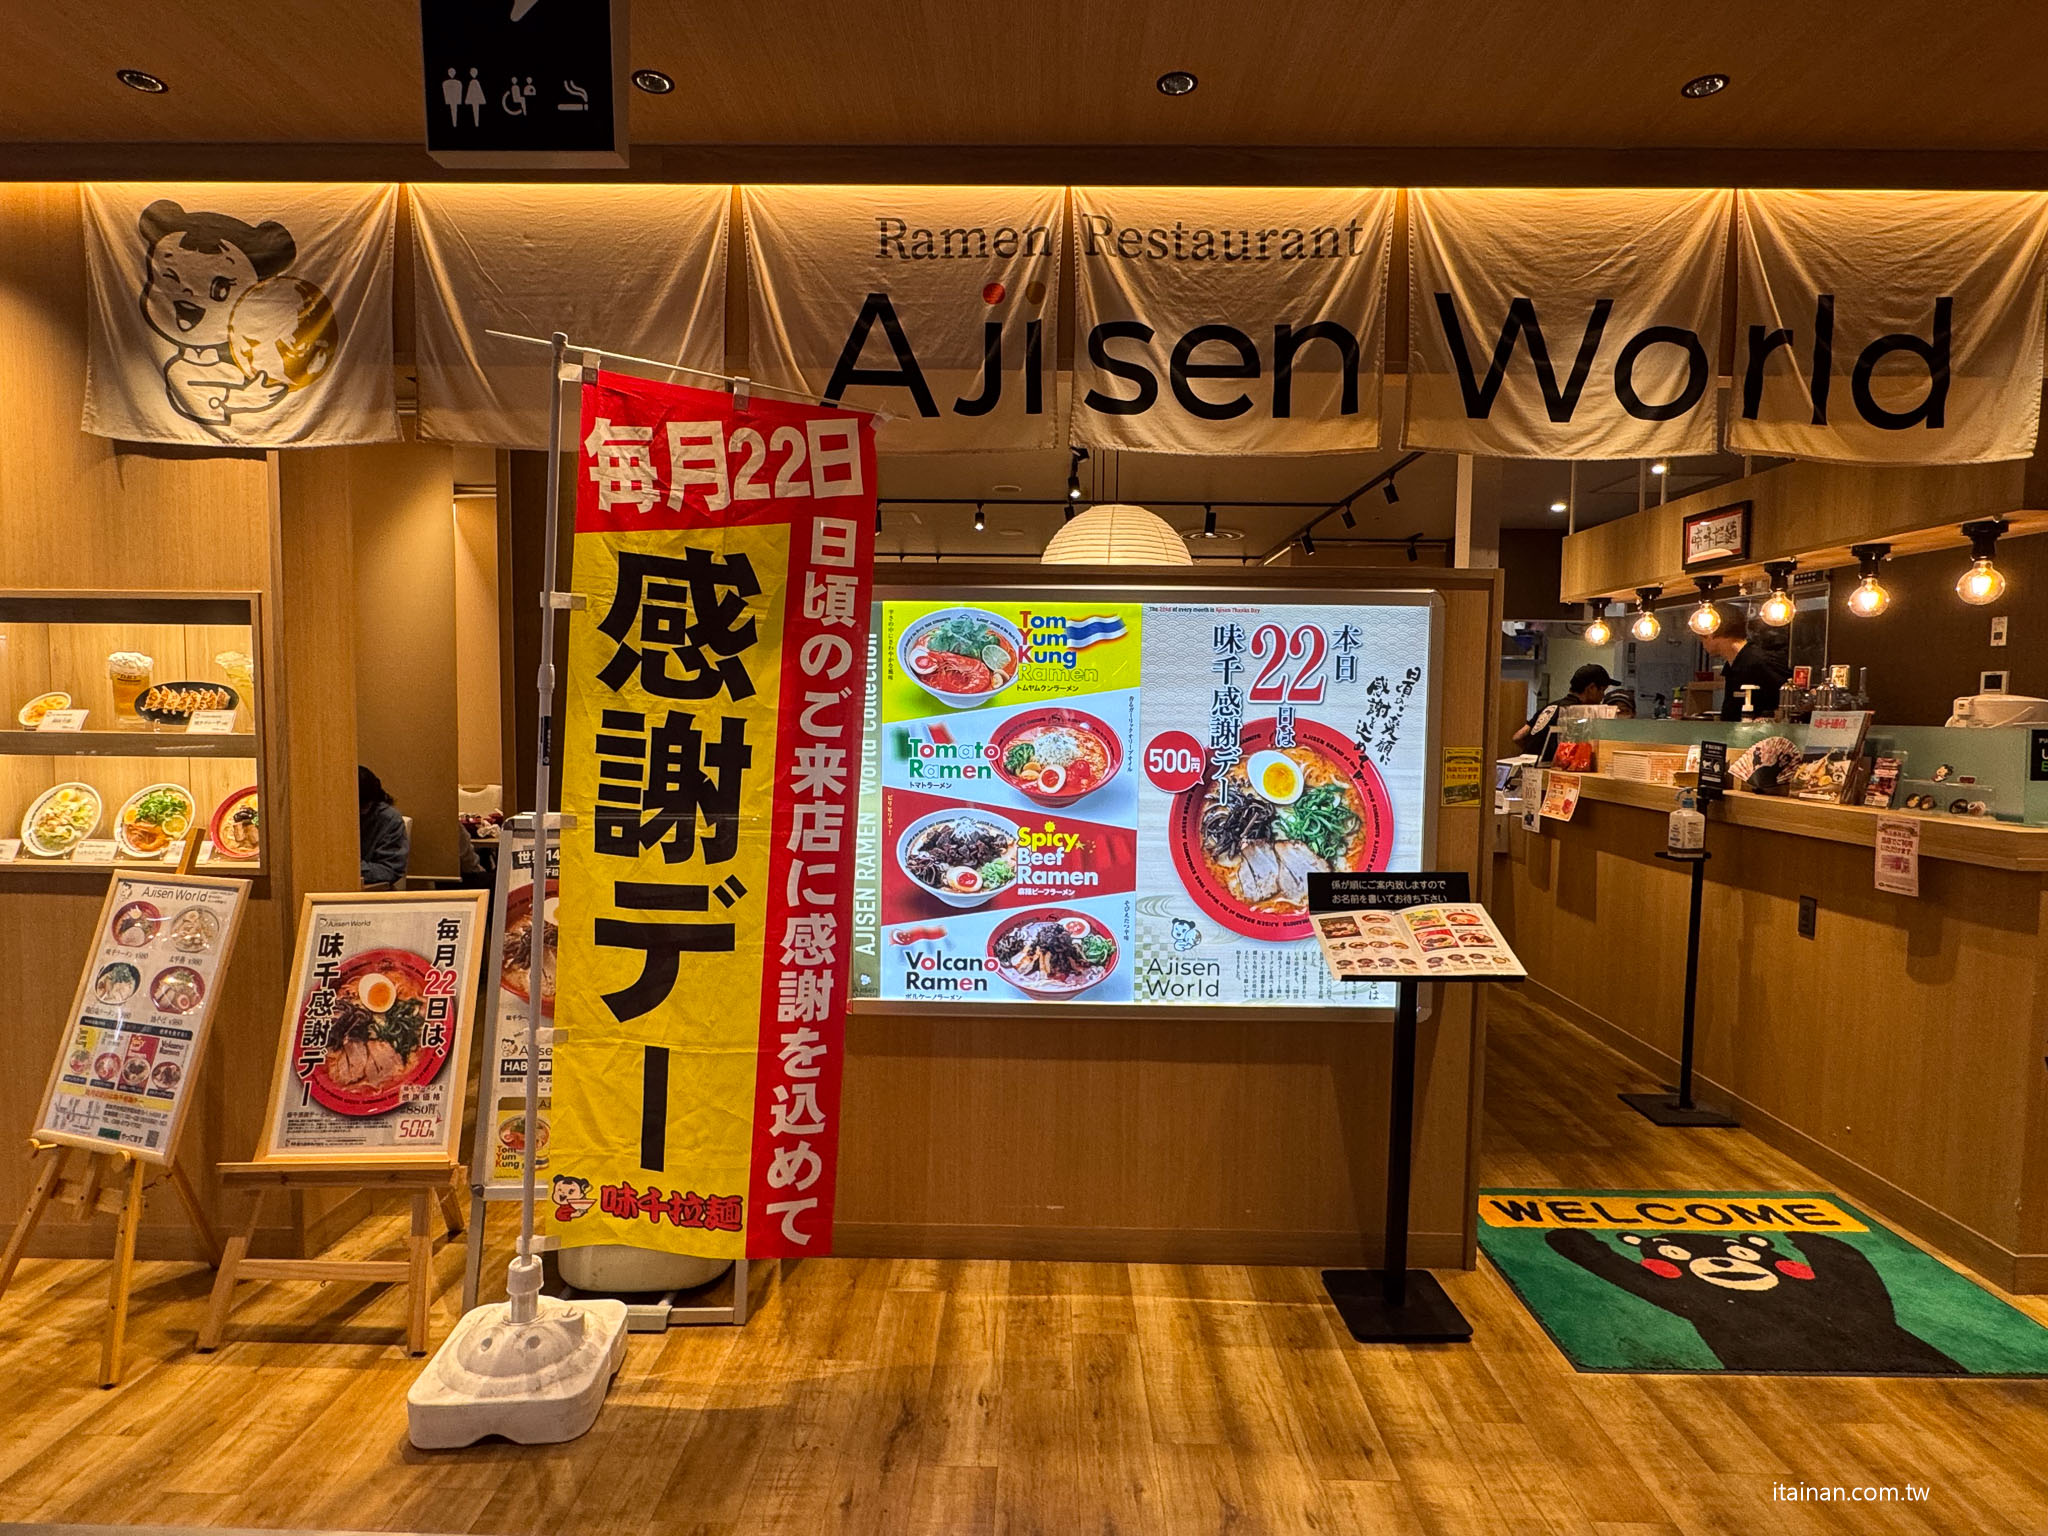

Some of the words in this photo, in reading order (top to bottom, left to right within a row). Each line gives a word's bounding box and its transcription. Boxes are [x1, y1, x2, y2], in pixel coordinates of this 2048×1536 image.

[875, 216, 1054, 259] Ramen
[1083, 213, 1364, 261] Restaurant
[821, 281, 1361, 420] Ajisen
[1433, 292, 1953, 430] World
[584, 416, 864, 514] 毎月22日
[1019, 610, 1067, 629] Tom
[1018, 629, 1068, 645] Yum
[1018, 646, 1077, 669] Kung
[1249, 624, 1328, 703] 22
[1333, 625, 1363, 682] 本日
[1018, 664, 1099, 682] Ramen
[1016, 684, 1079, 692] トムヤムクンラーメン
[1210, 624, 1246, 806] 味千感謝デー
[1275, 705, 1296, 747] 日は
[909, 738, 1000, 760] Tomato
[859, 739, 877, 796] World
[909, 760, 992, 779] Ramen
[1149, 748, 1201, 774] 500円
[909, 781, 952, 789] トマトラーメン
[857, 810, 877, 884] RAMEN
[1018, 821, 1080, 853] Spicy
[593, 546, 762, 1172] 感謝デー
[1018, 848, 1065, 866] Beef
[766, 516, 857, 1246] 日頃のご来店に感謝を込めて
[1018, 866, 1099, 886] Ramen
[1331, 879, 1447, 891] 係が順にご案内致しますので
[141, 886, 174, 899] Ajisen
[175, 888, 208, 902] World
[1331, 893, 1448, 905] お名前を書いてお待ち下さい
[855, 902, 877, 956] AJISEN
[905, 950, 999, 972] Volcano
[1147, 957, 1220, 976] Ajisen
[420, 918, 460, 1058] 毎月22日は、
[905, 973, 988, 991] Ramen
[1146, 978, 1220, 997] World
[298, 932, 345, 1107] 味千感謝デー
[399, 1119, 434, 1138] 500円
[496, 1153, 517, 1161] Yum
[497, 1145, 517, 1154] Tom
[495, 1160, 520, 1170] Kung
[1490, 1197, 1841, 1228] WELCOME
